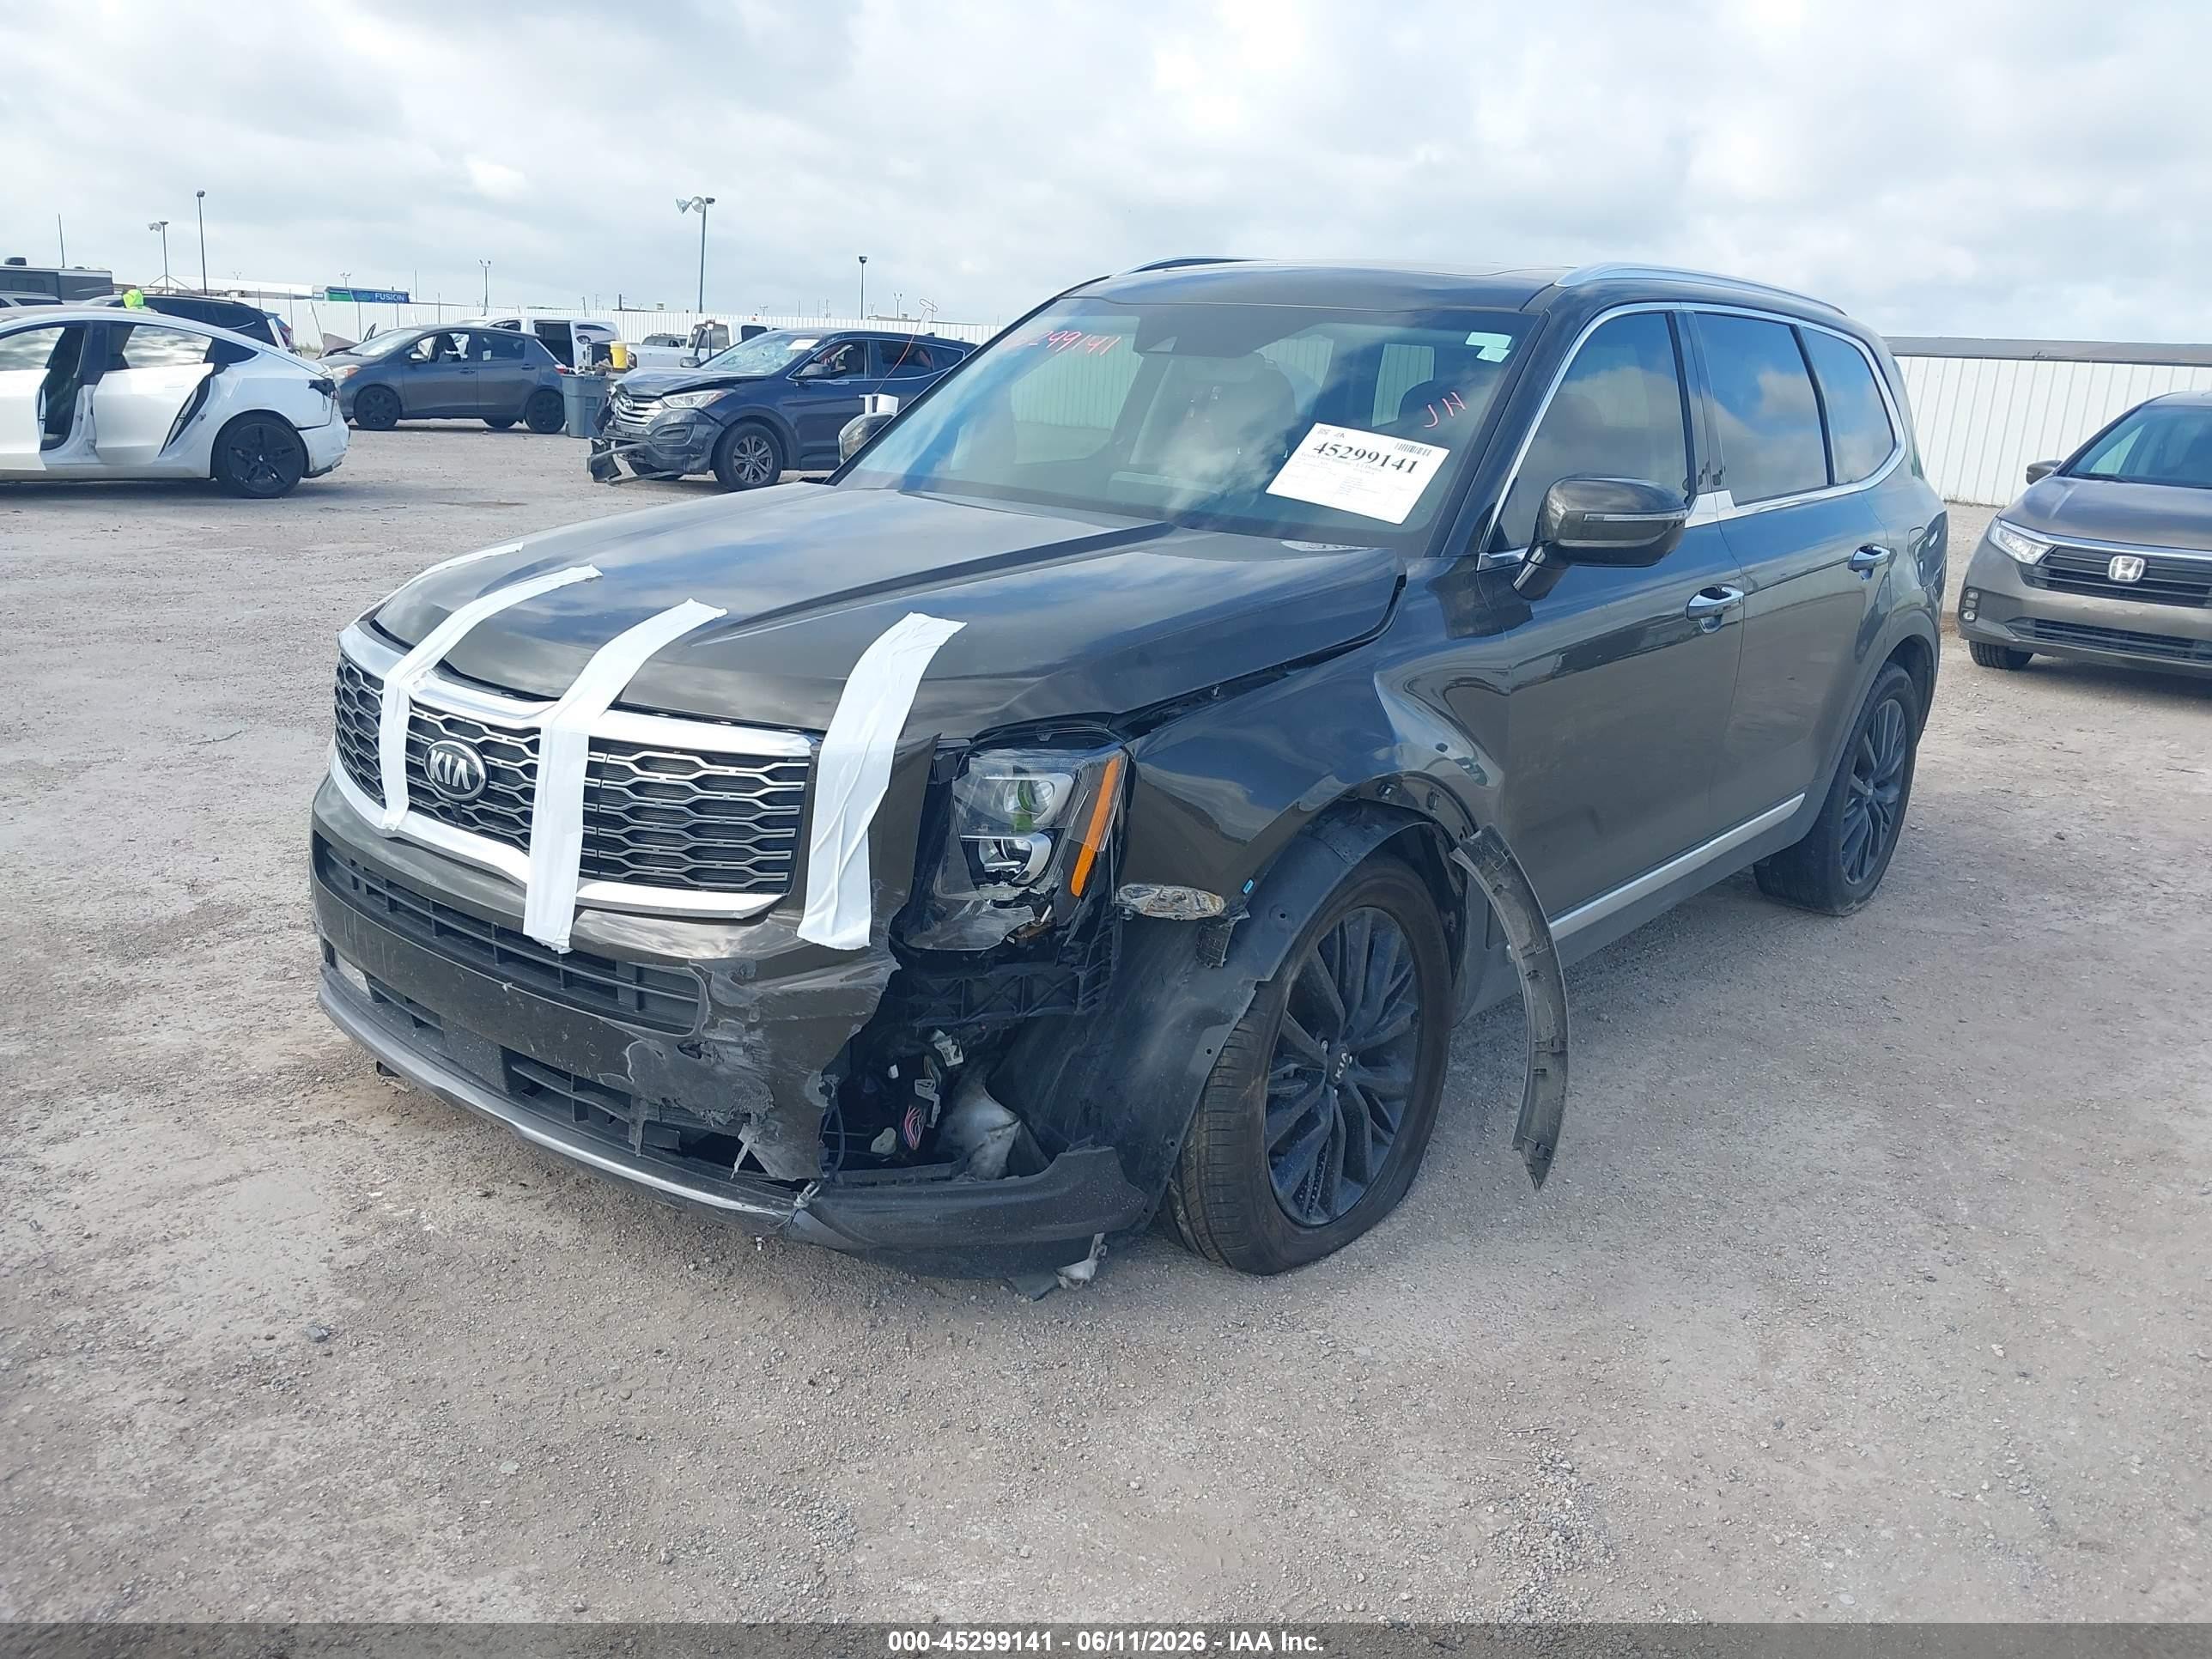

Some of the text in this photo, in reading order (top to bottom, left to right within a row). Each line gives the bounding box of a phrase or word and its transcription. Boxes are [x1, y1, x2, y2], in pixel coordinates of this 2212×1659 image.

[374, 292, 405, 301] FUSION
[1312, 441, 1419, 474] 45299141
[430, 750, 471, 790] KIA
[1335, 1053, 1347, 1079] KIA
